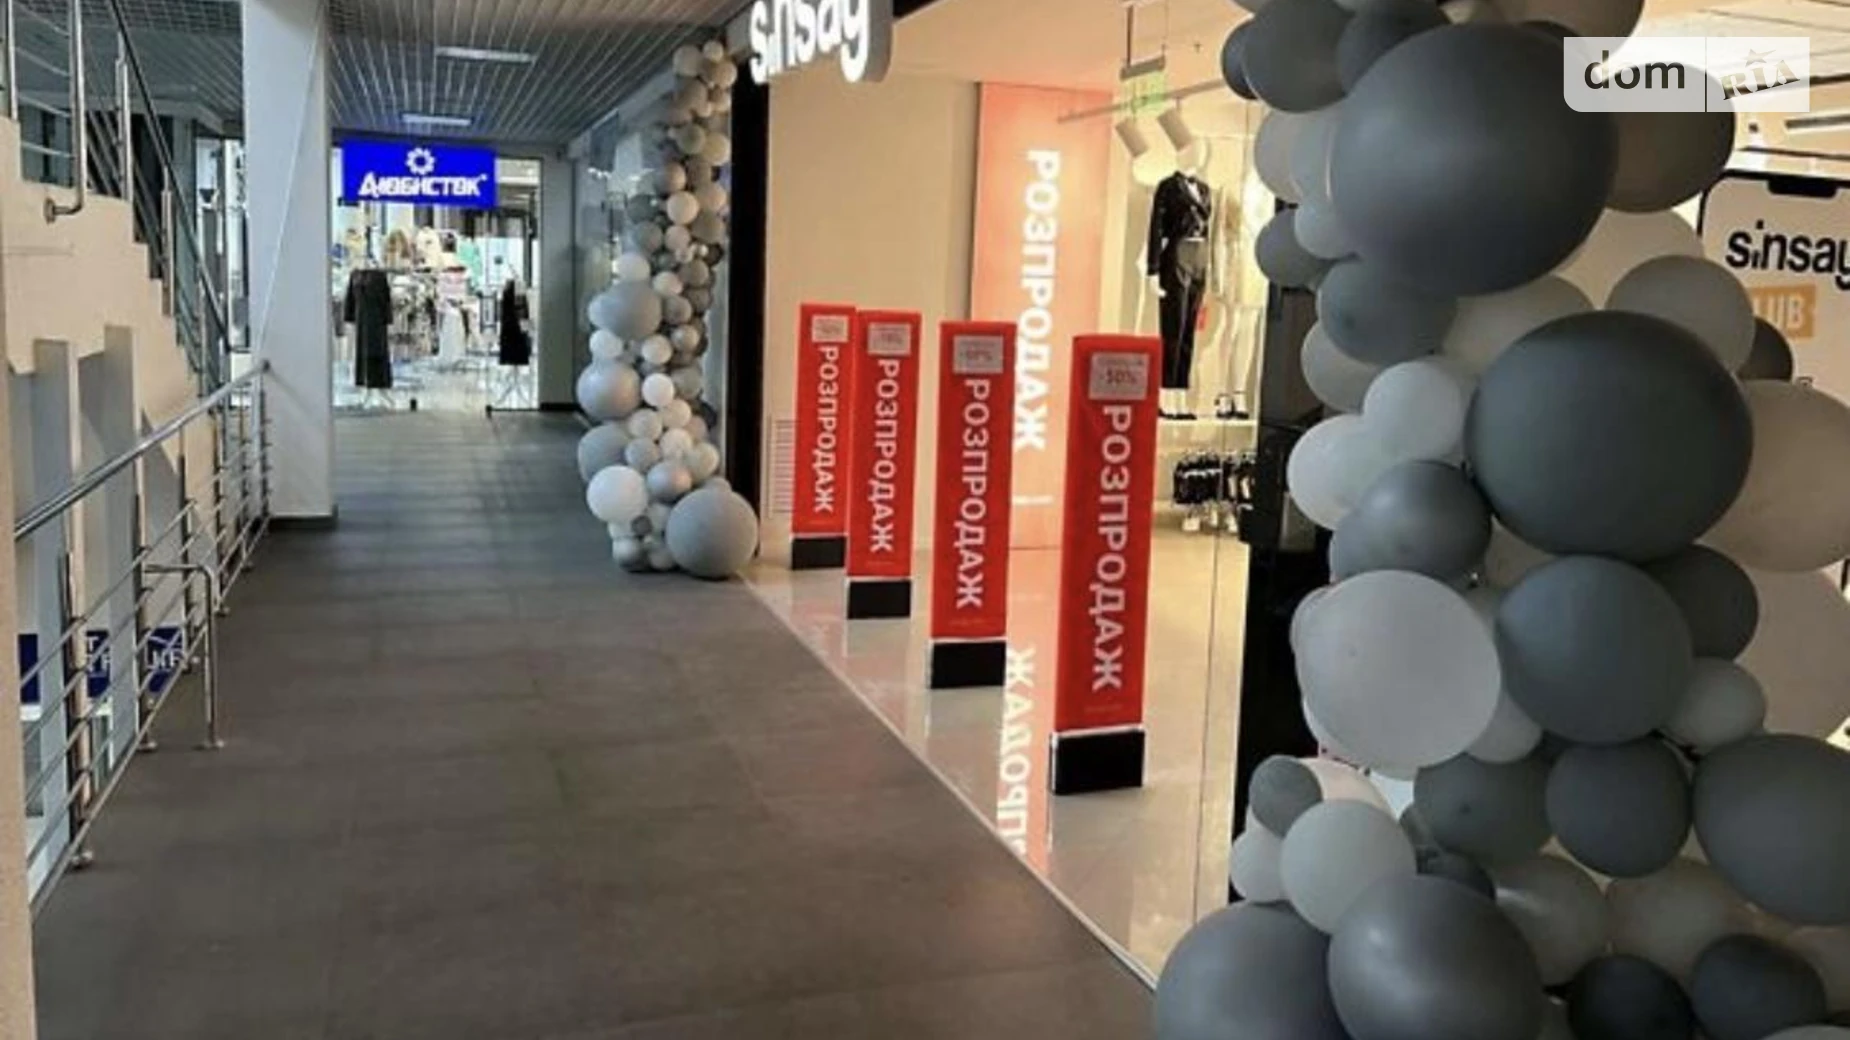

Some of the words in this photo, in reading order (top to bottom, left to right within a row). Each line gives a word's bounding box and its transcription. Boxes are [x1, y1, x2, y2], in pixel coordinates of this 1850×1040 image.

[1013, 149, 1061, 450] РОЗПРОДАЖ
[812, 346, 840, 513] РОЗПРОДАЖ
[868, 360, 900, 553] РОЗПРОДАЖ
[955, 379, 990, 610] РОЗПРОДАЖ
[1089, 405, 1132, 693] РОЗПРОДАЖ
